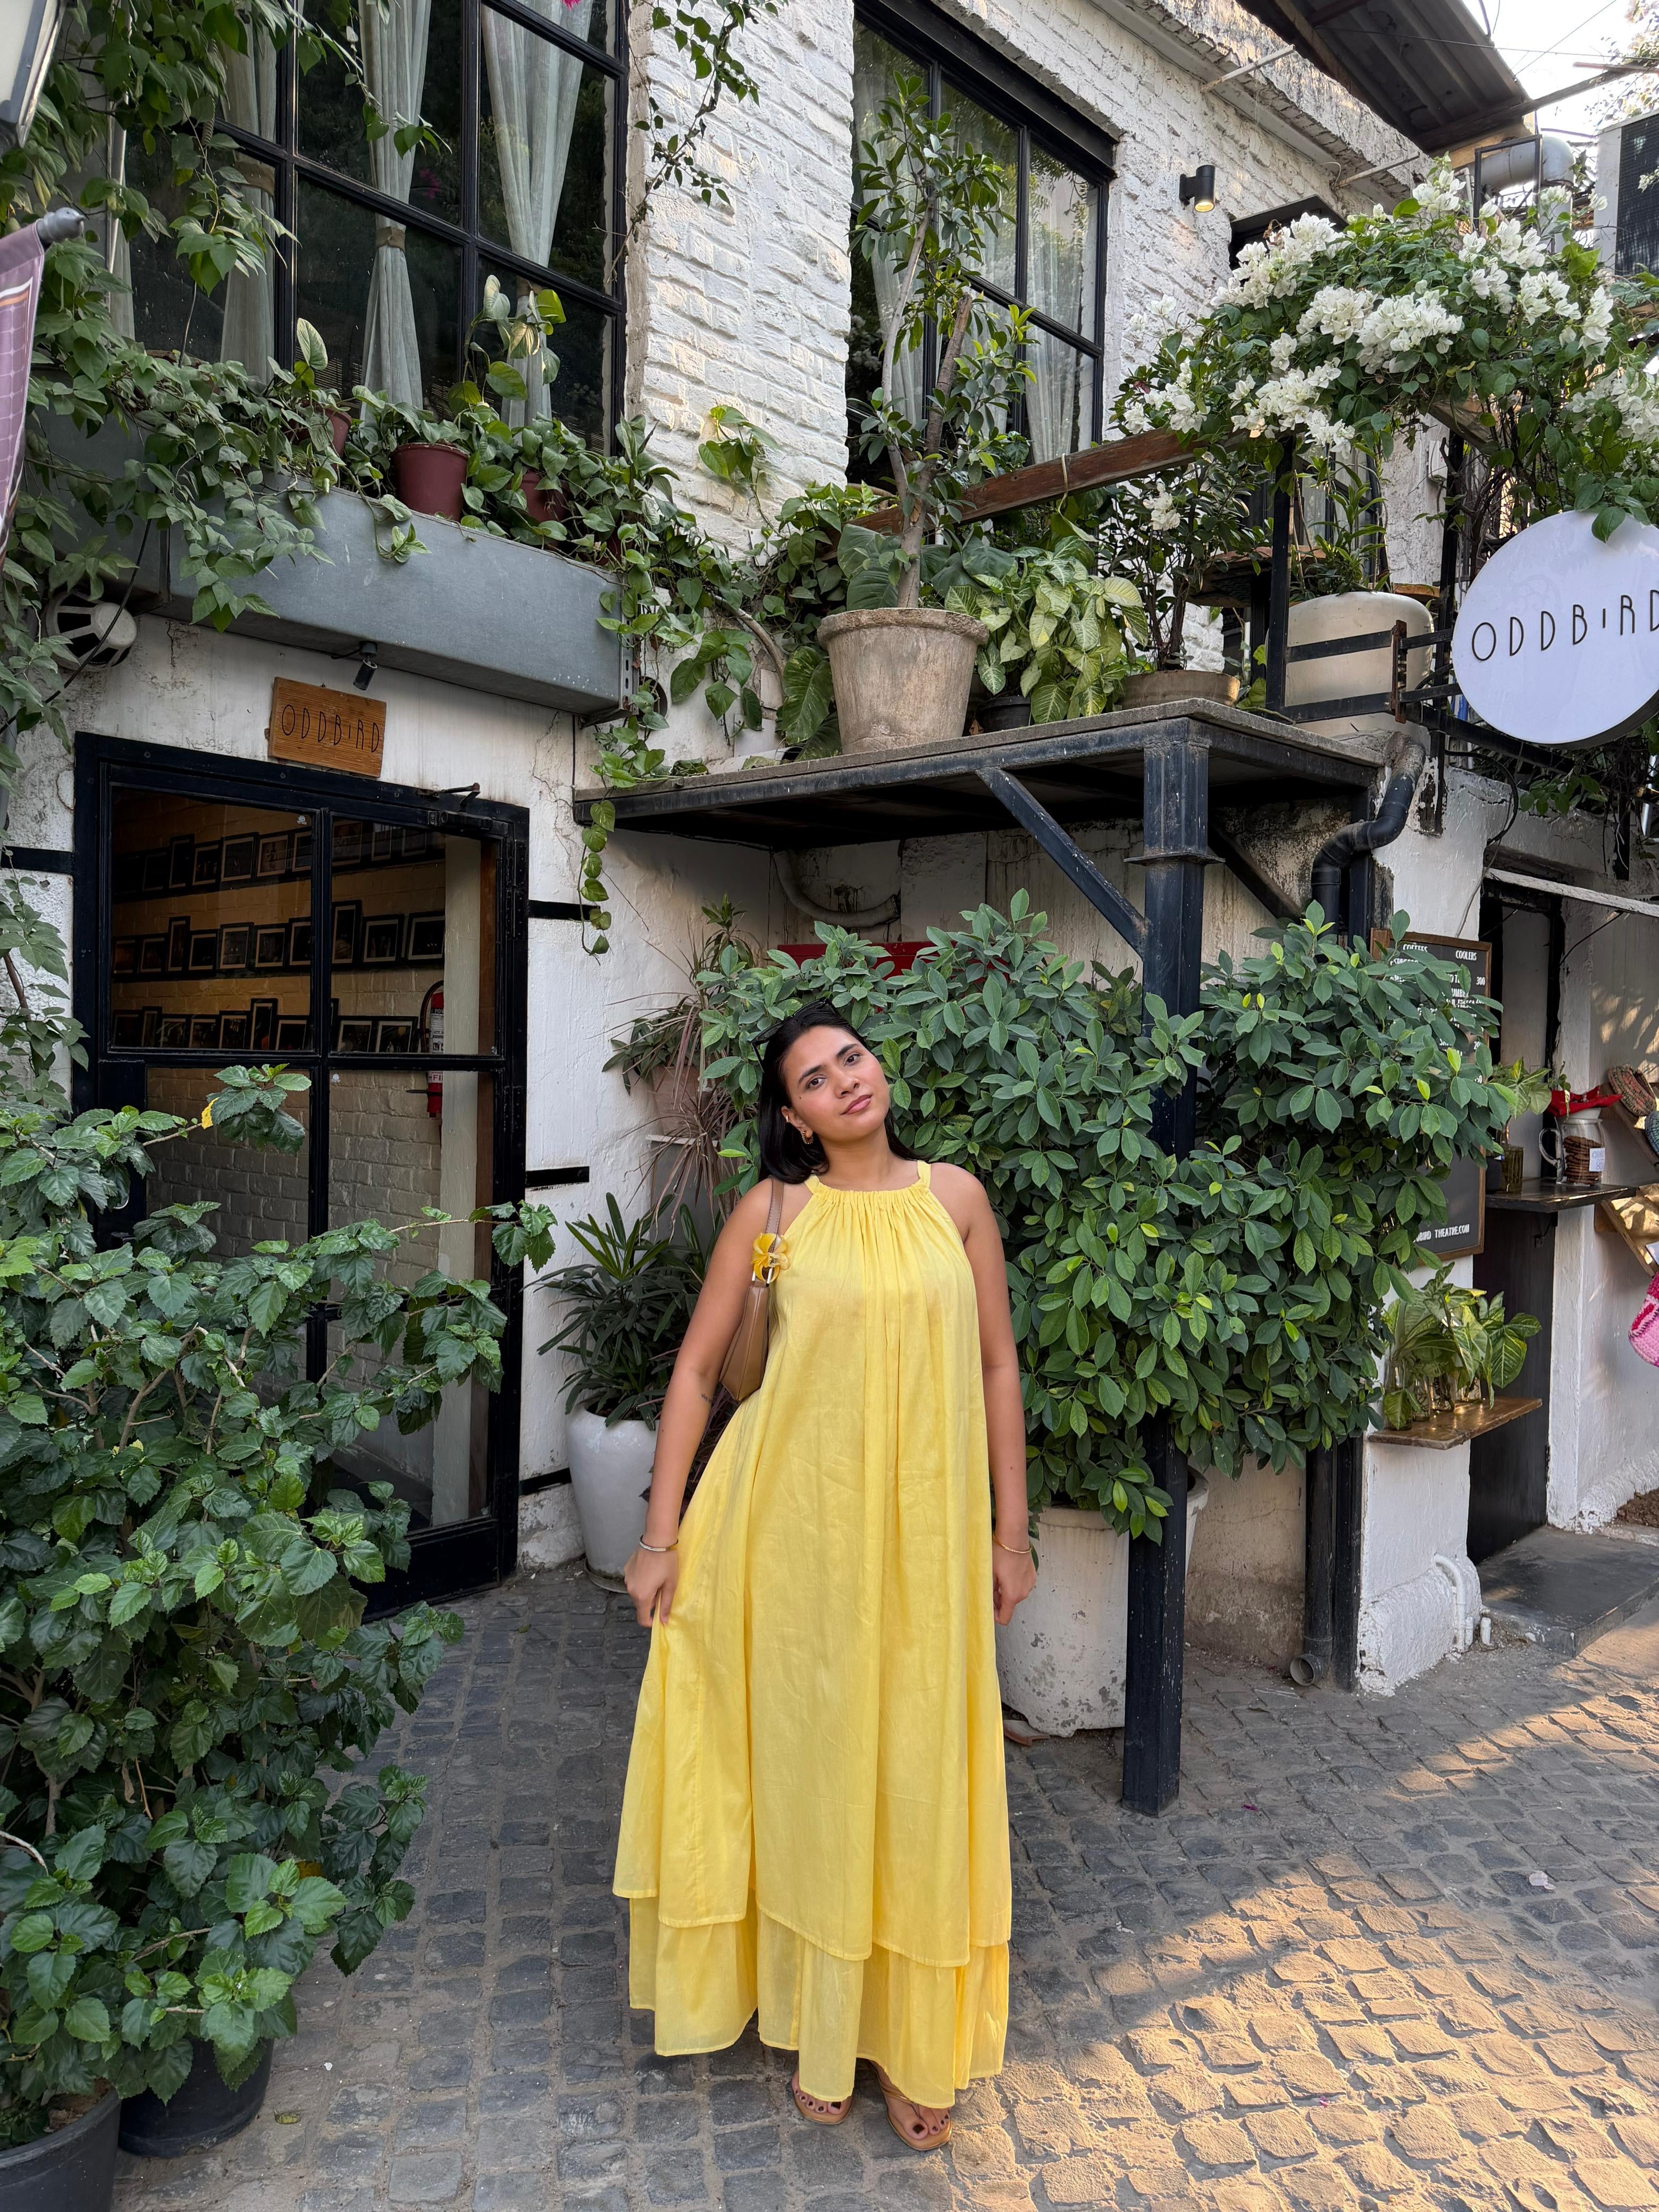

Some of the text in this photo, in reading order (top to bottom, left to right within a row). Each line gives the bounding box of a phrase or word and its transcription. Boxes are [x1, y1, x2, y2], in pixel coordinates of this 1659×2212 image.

[1472, 590, 1659, 661] ODDBIRD
[282, 704, 380, 753] ODDBIRD
[1455, 950, 1477, 961] COOLERS
[1476, 976, 1486, 986] 300
